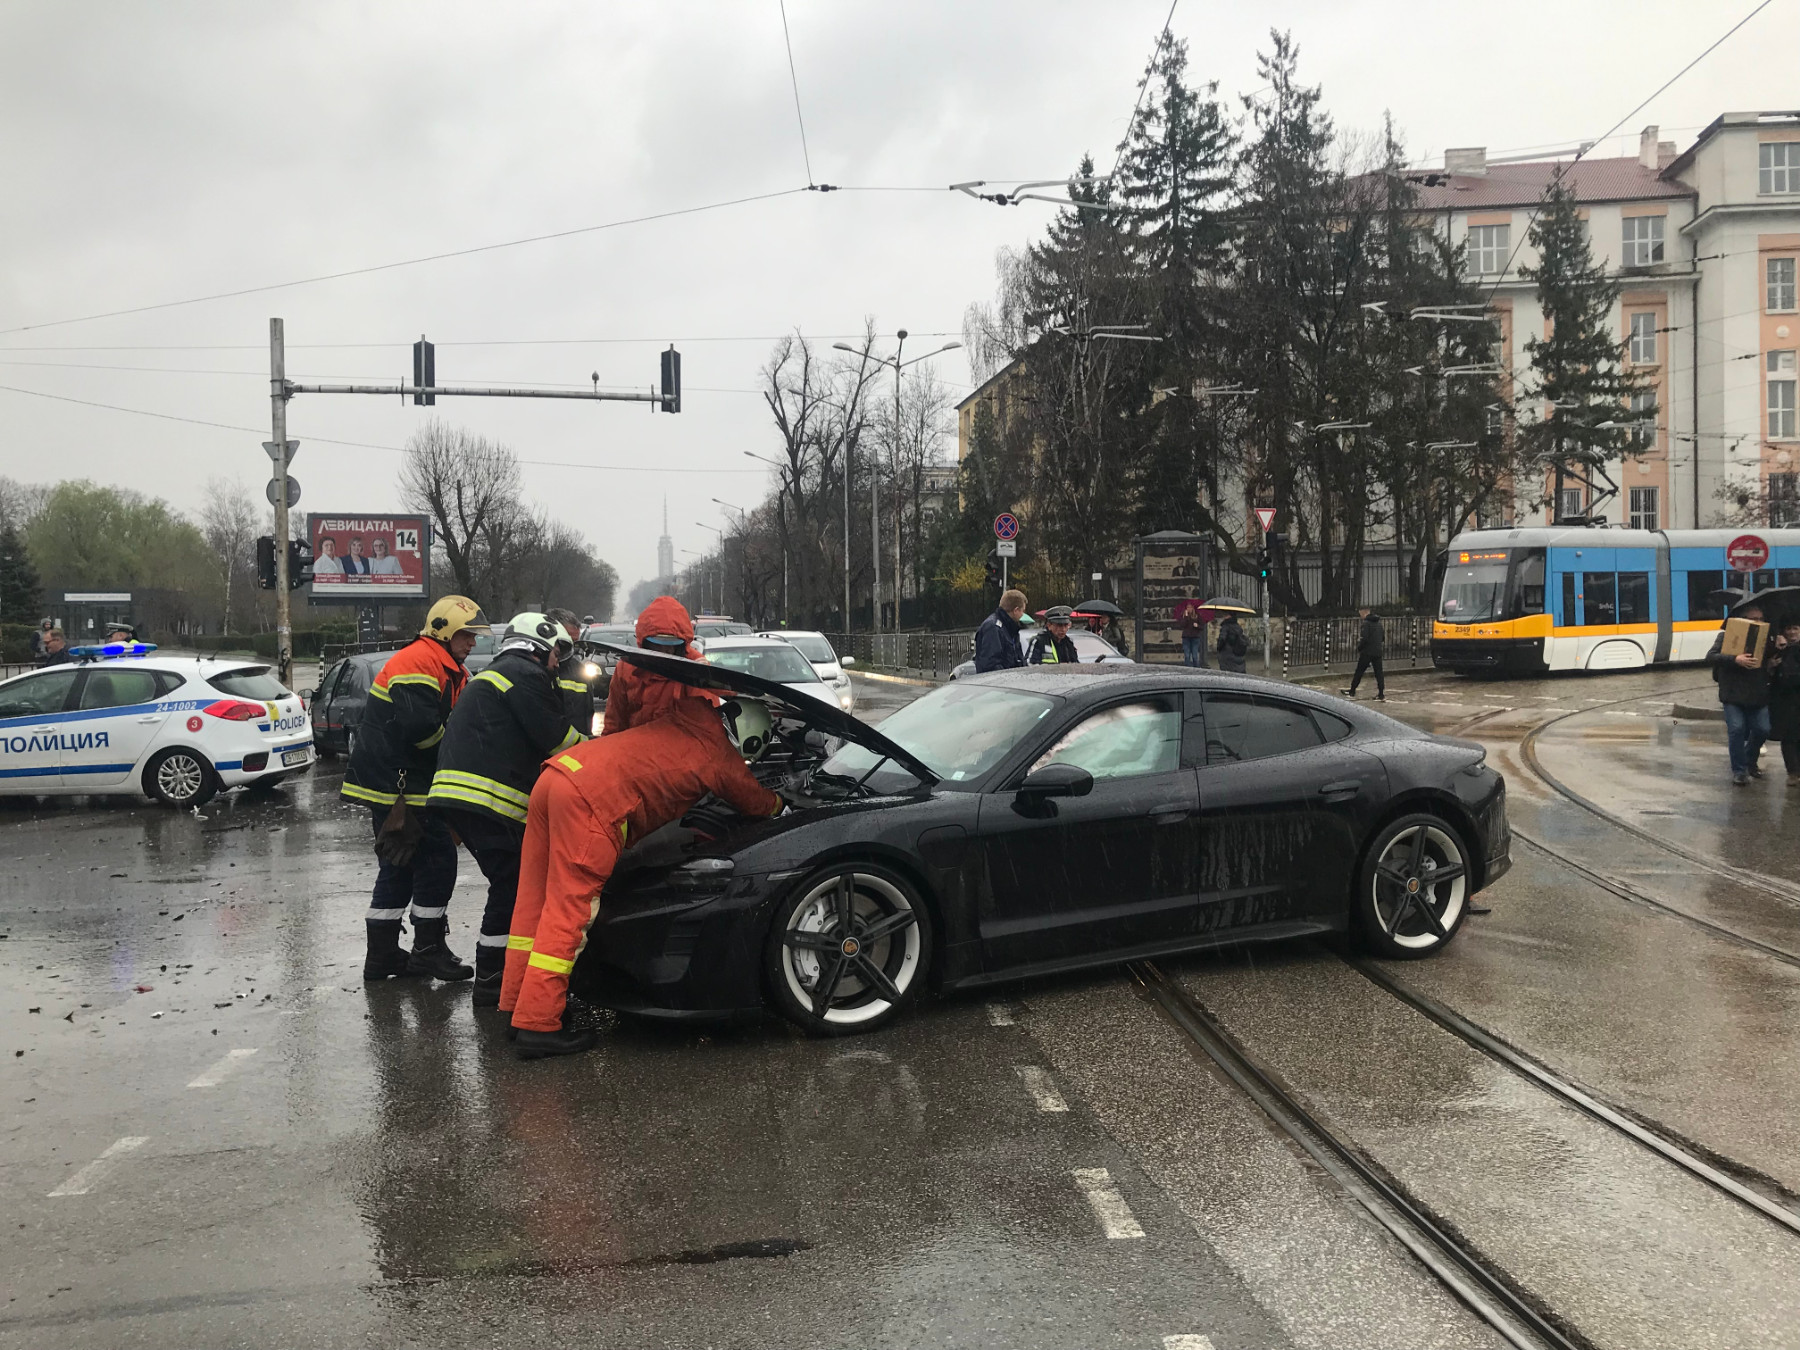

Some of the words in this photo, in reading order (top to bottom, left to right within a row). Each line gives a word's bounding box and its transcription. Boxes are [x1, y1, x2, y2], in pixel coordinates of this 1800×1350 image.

[318, 520, 394, 534] ЛЕВИЦАТА!
[397, 531, 417, 548] 14
[156, 701, 197, 712] 24-1002
[191, 719, 198, 729] 3
[274, 715, 303, 731] POLICE
